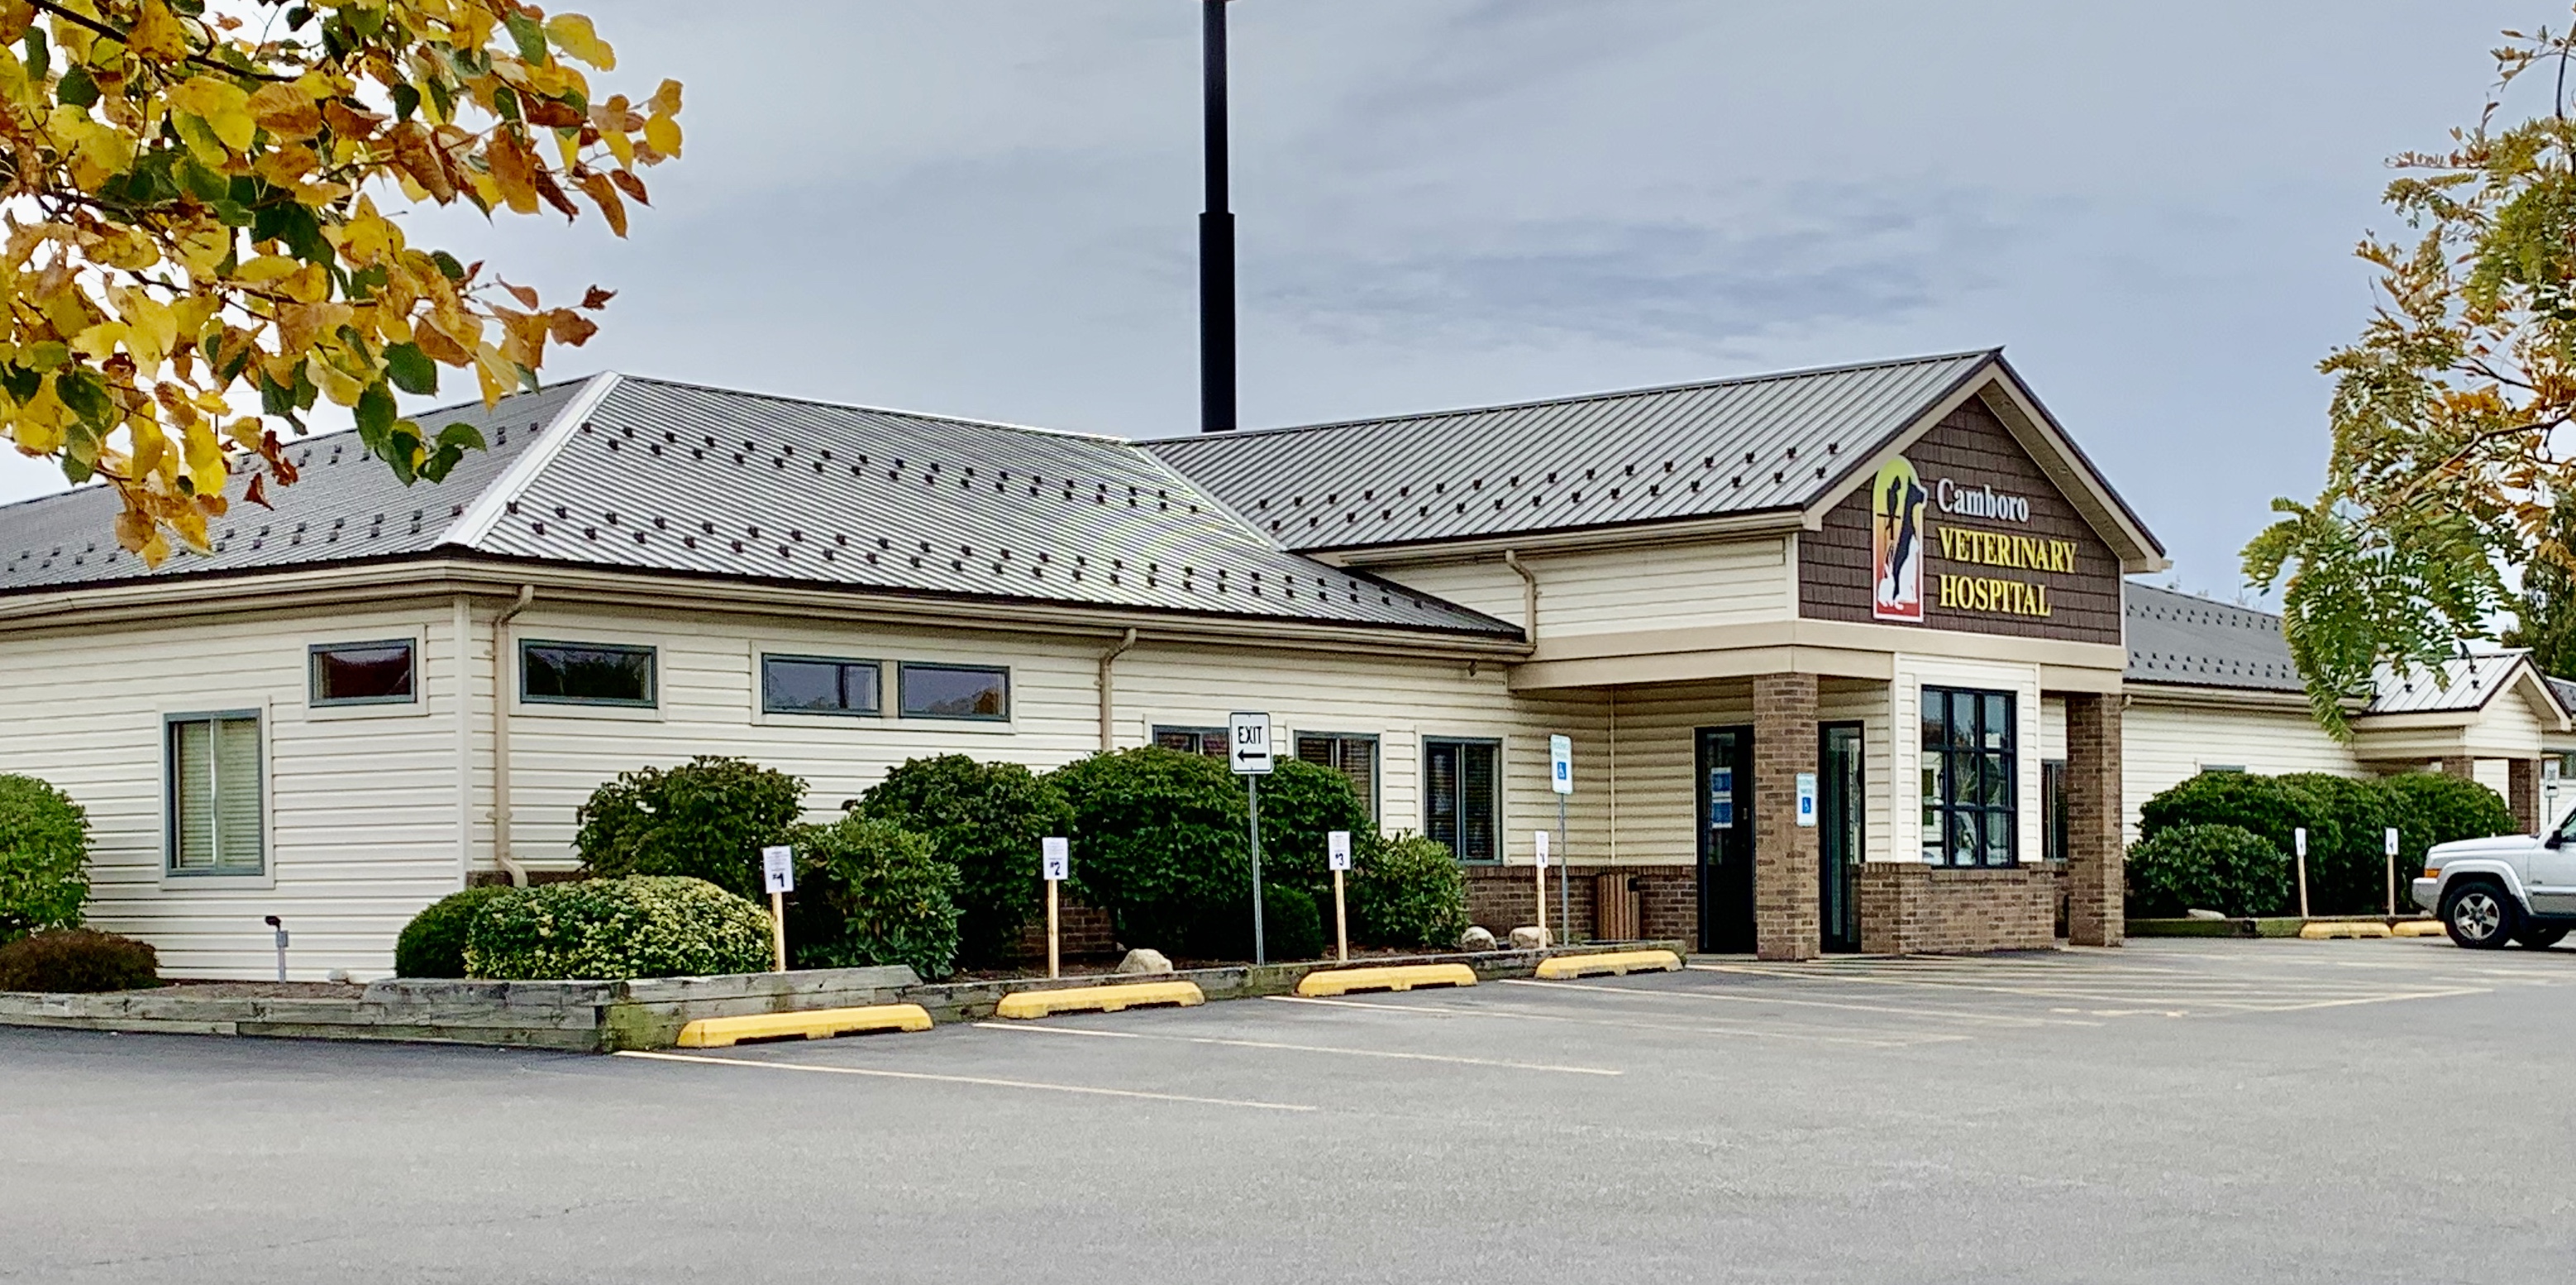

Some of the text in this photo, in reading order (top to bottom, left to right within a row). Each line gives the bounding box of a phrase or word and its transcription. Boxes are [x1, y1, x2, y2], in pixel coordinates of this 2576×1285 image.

[1937, 477, 2029, 523] Camboro
[1938, 527, 2077, 573] VETERINARY
[1939, 574, 2051, 617] HOSPITAL
[1238, 725, 1262, 744] EXIT
